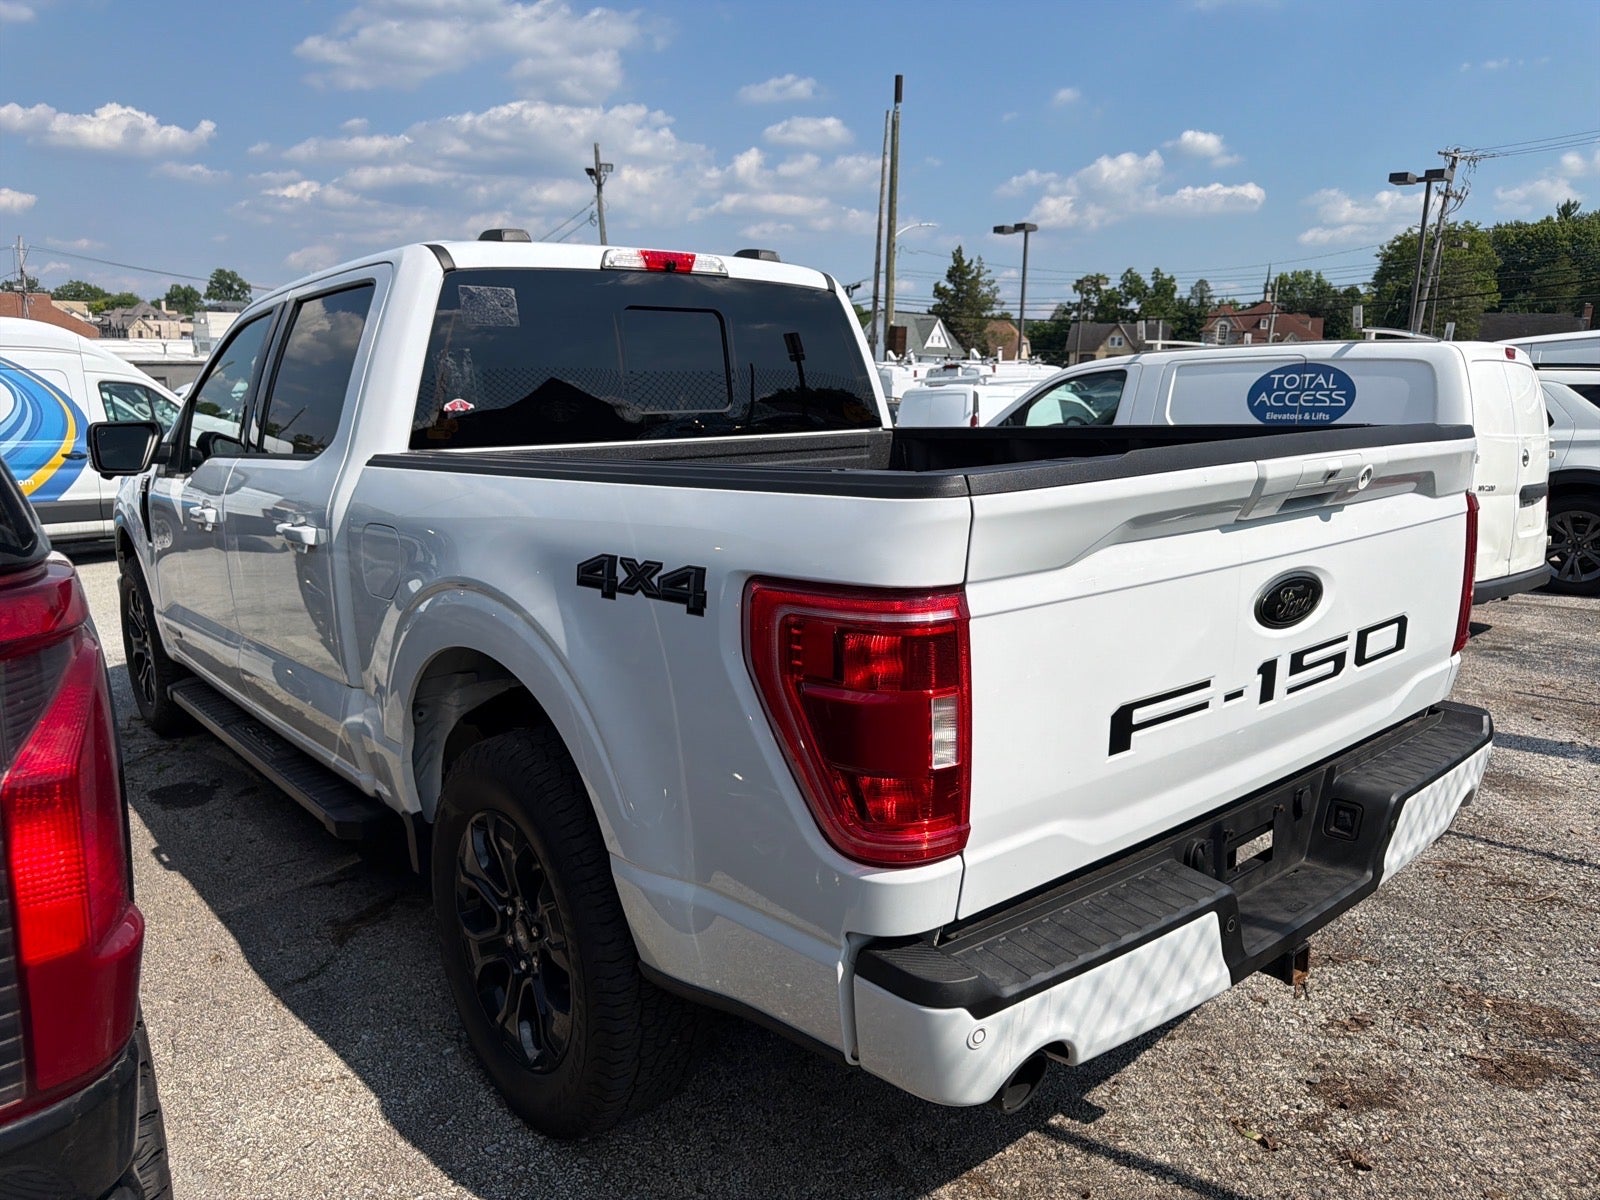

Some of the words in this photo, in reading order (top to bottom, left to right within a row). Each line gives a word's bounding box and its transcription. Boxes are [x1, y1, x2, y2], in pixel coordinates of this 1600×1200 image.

[1270, 373, 1337, 389] TOTAL
[1254, 391, 1346, 406] ACCESS
[1266, 412, 1302, 420] Elevators
[1311, 412, 1330, 421] Lifts
[1276, 585, 1313, 619] Ford
[1108, 613, 1408, 757] F-150
